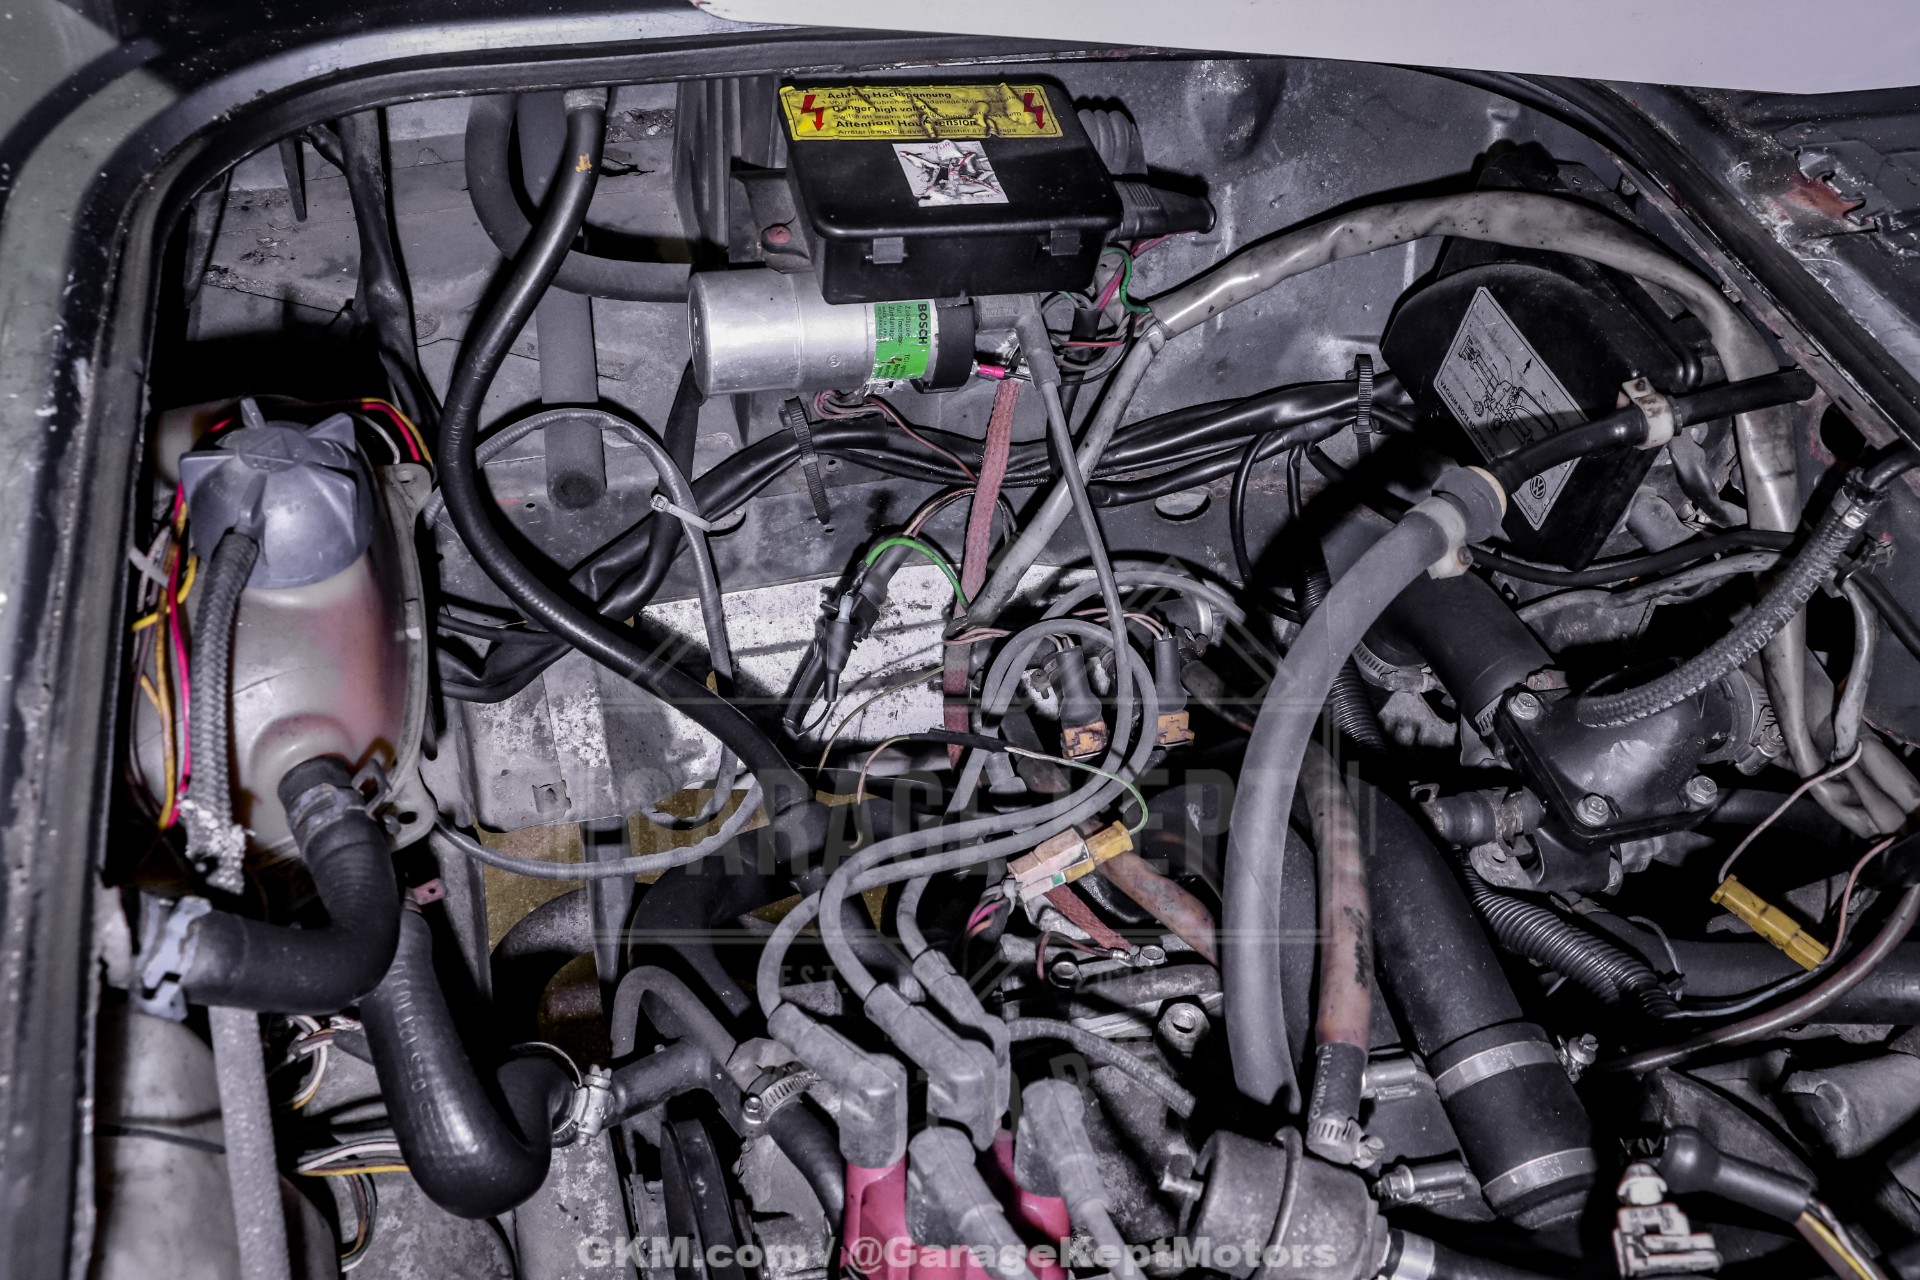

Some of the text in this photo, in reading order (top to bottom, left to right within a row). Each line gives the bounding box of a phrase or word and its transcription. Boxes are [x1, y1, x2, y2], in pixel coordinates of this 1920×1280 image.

[836, 119, 895, 128] Attention!
[918, 303, 929, 345] BOSCH
[1440, 380, 1459, 406] VACUUM
[1726, 620, 1777, 669] MADE
[1773, 601, 1797, 625] IN
